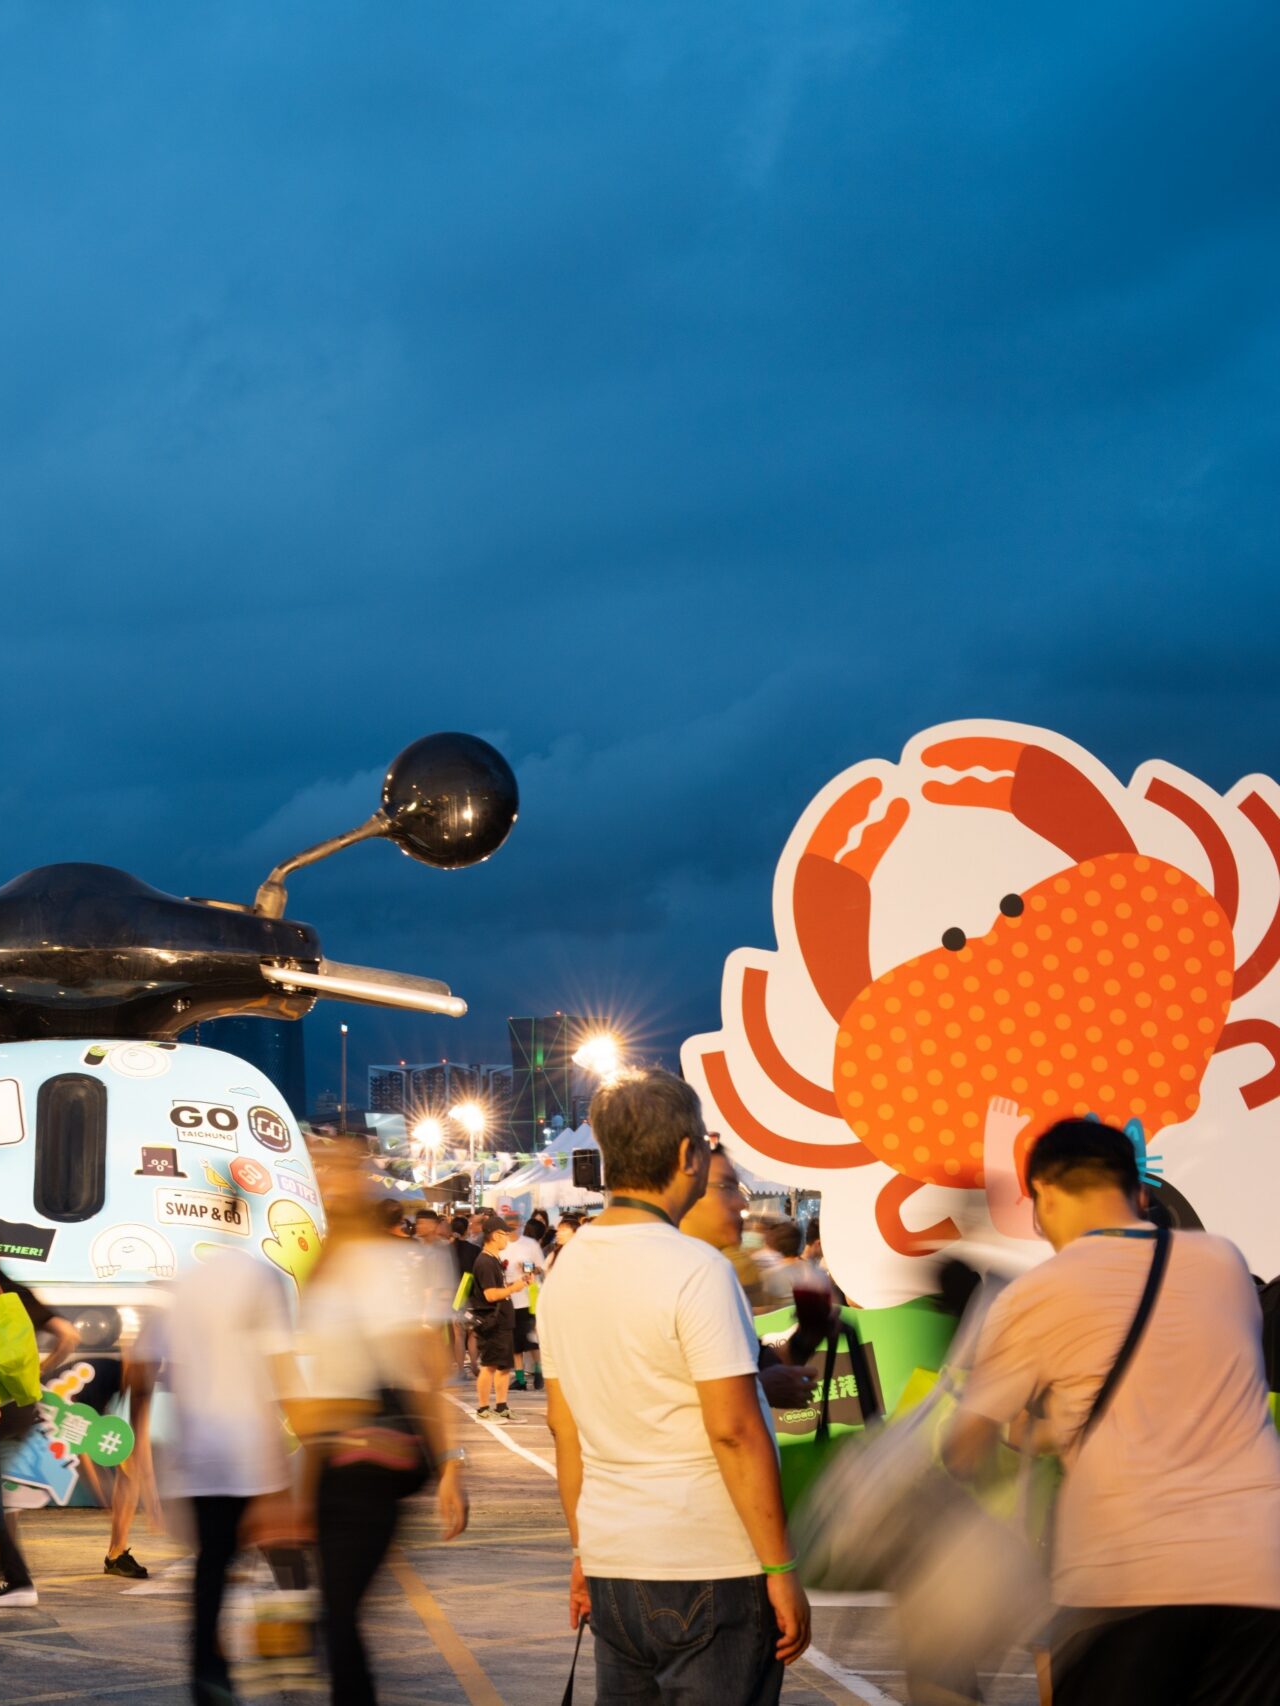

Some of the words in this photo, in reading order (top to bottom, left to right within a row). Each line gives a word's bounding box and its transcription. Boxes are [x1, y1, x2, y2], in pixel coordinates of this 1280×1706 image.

[170, 1105, 239, 1131] GO
[256, 1117, 284, 1141] GO
[181, 1131, 234, 1142] TAICHUNG
[238, 1163, 263, 1186] GO
[280, 1177, 297, 1193] GO
[165, 1201, 208, 1219] SWAP
[211, 1208, 222, 1221] &
[224, 1210, 241, 1225] GO
